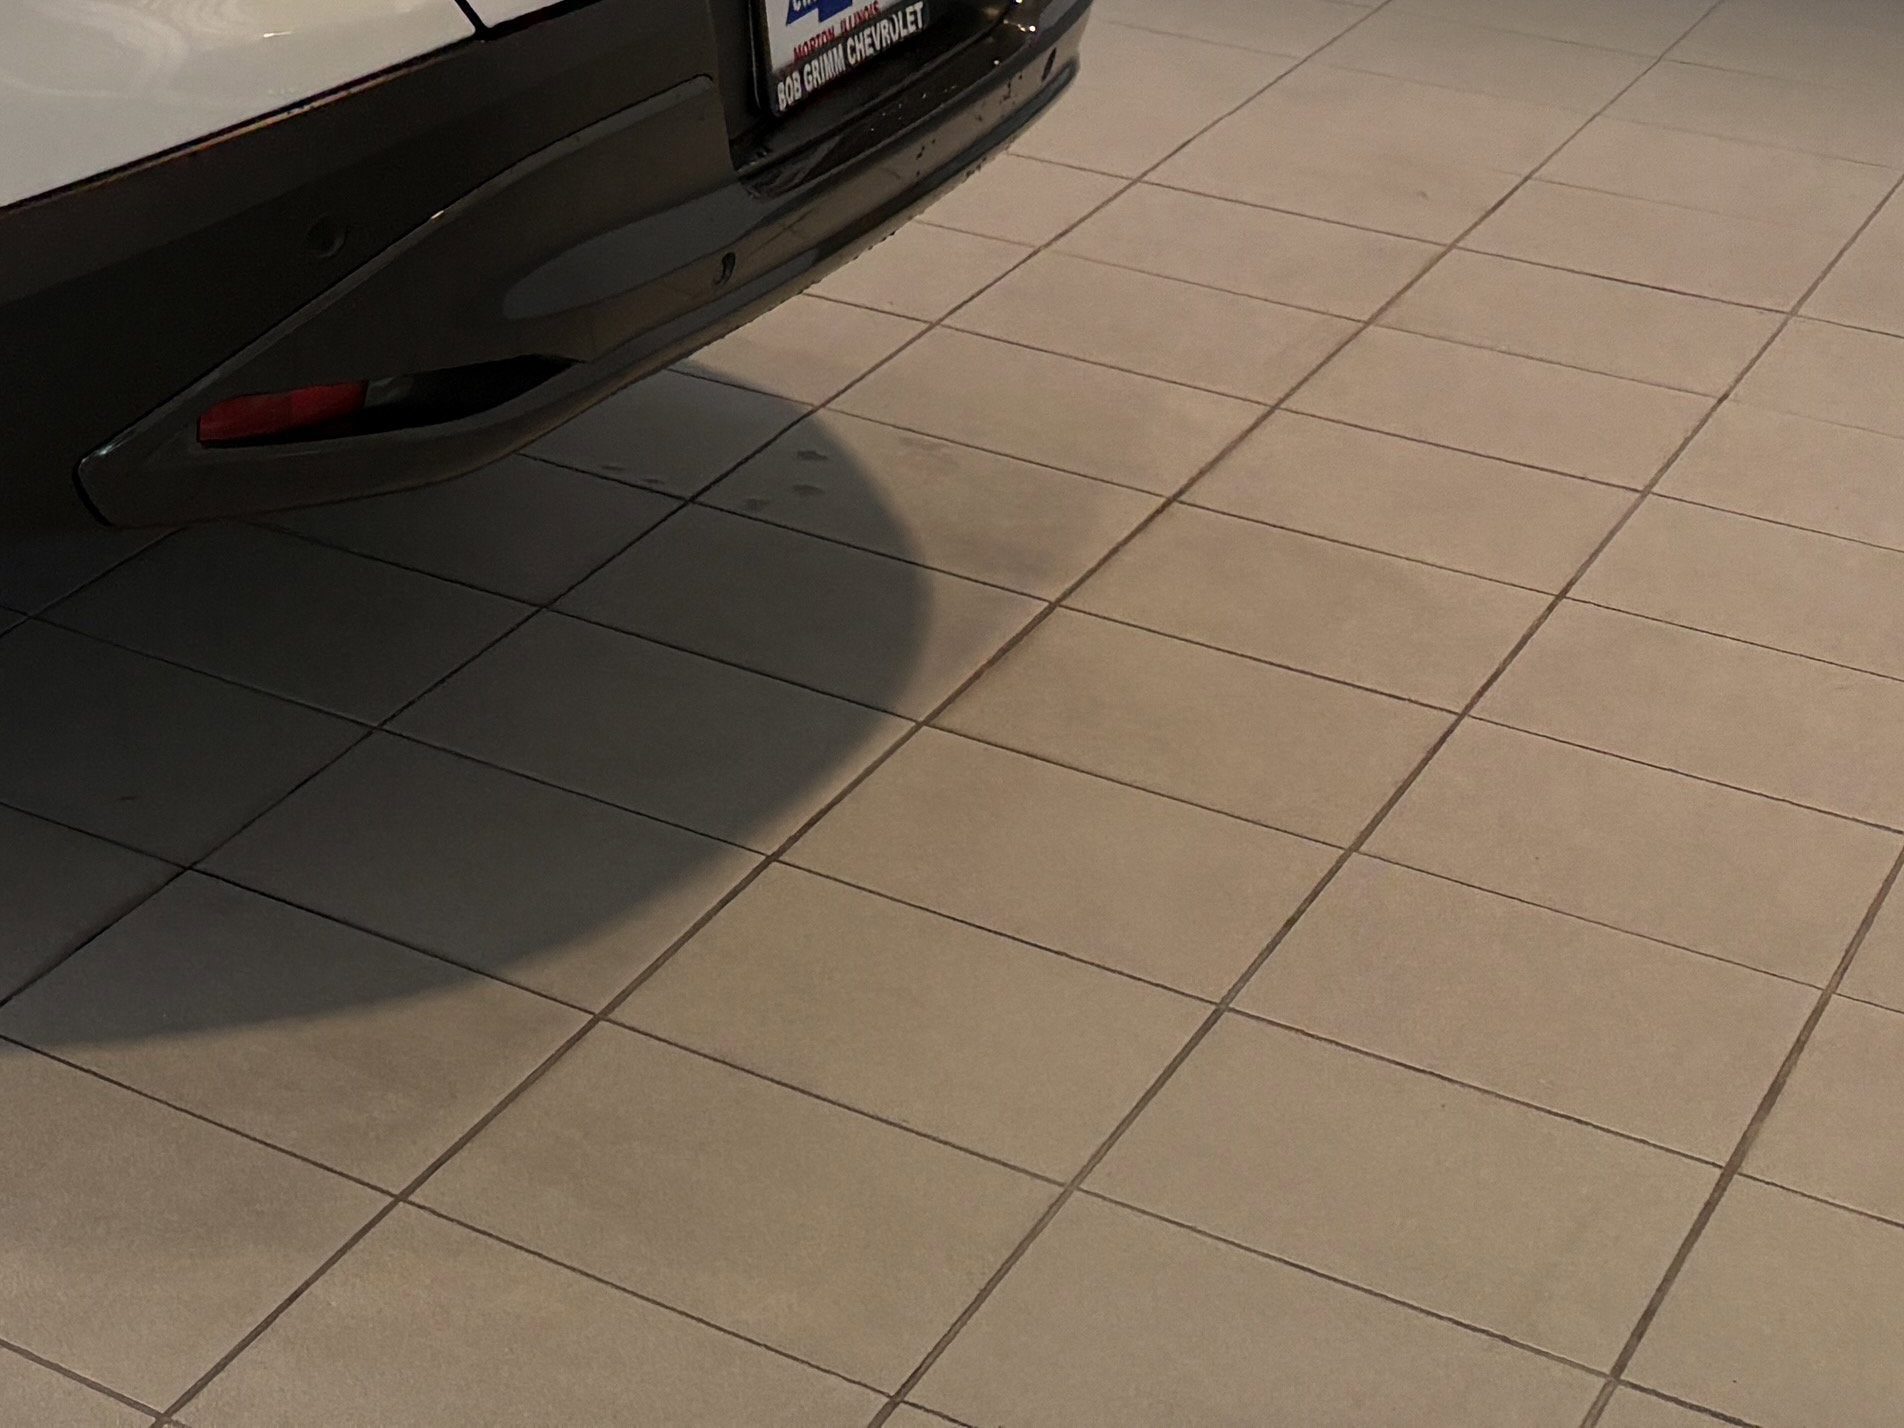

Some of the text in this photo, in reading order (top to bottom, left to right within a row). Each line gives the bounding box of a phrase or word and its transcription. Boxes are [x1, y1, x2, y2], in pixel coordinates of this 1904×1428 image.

[777, 0, 925, 112] BOB GRIMM CHEVROLET
